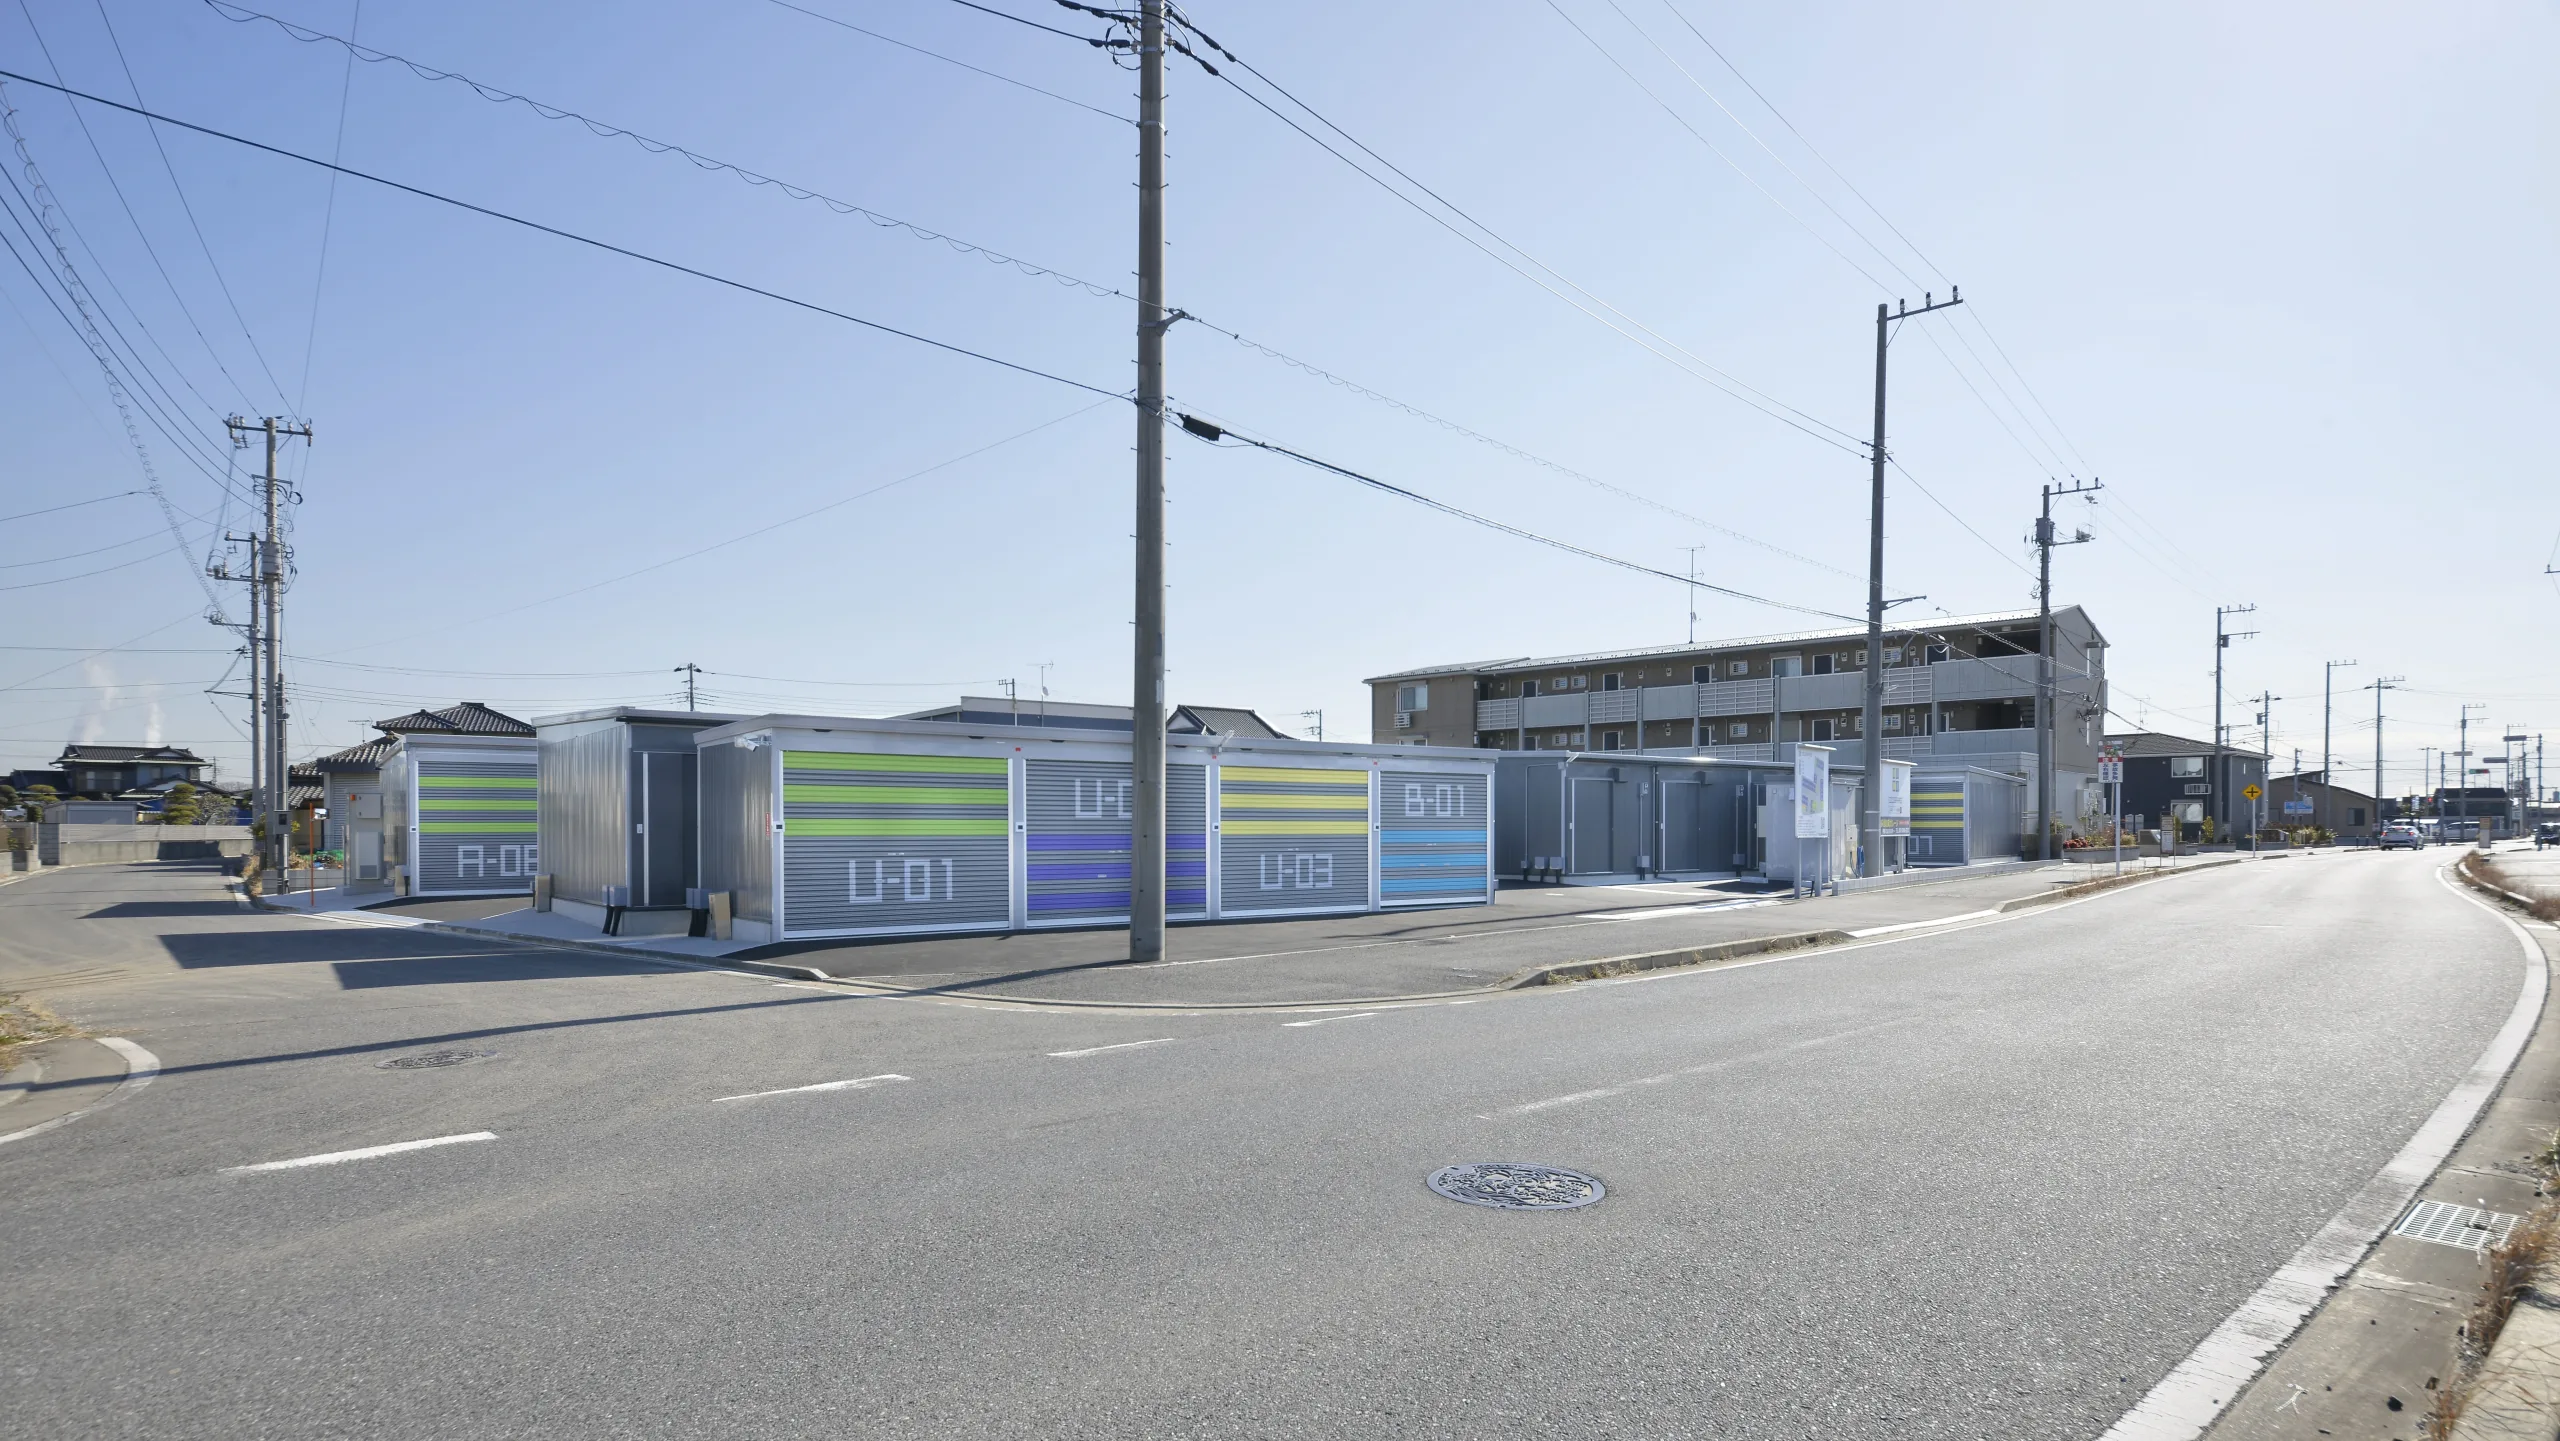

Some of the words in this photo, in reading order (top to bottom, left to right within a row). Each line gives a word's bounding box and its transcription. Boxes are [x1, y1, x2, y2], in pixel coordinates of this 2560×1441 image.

[1075, 778, 1132, 818] U-0
[1405, 784, 1466, 817] B-01
[848, 859, 954, 904] U-01
[1261, 854, 1334, 890] U-03
